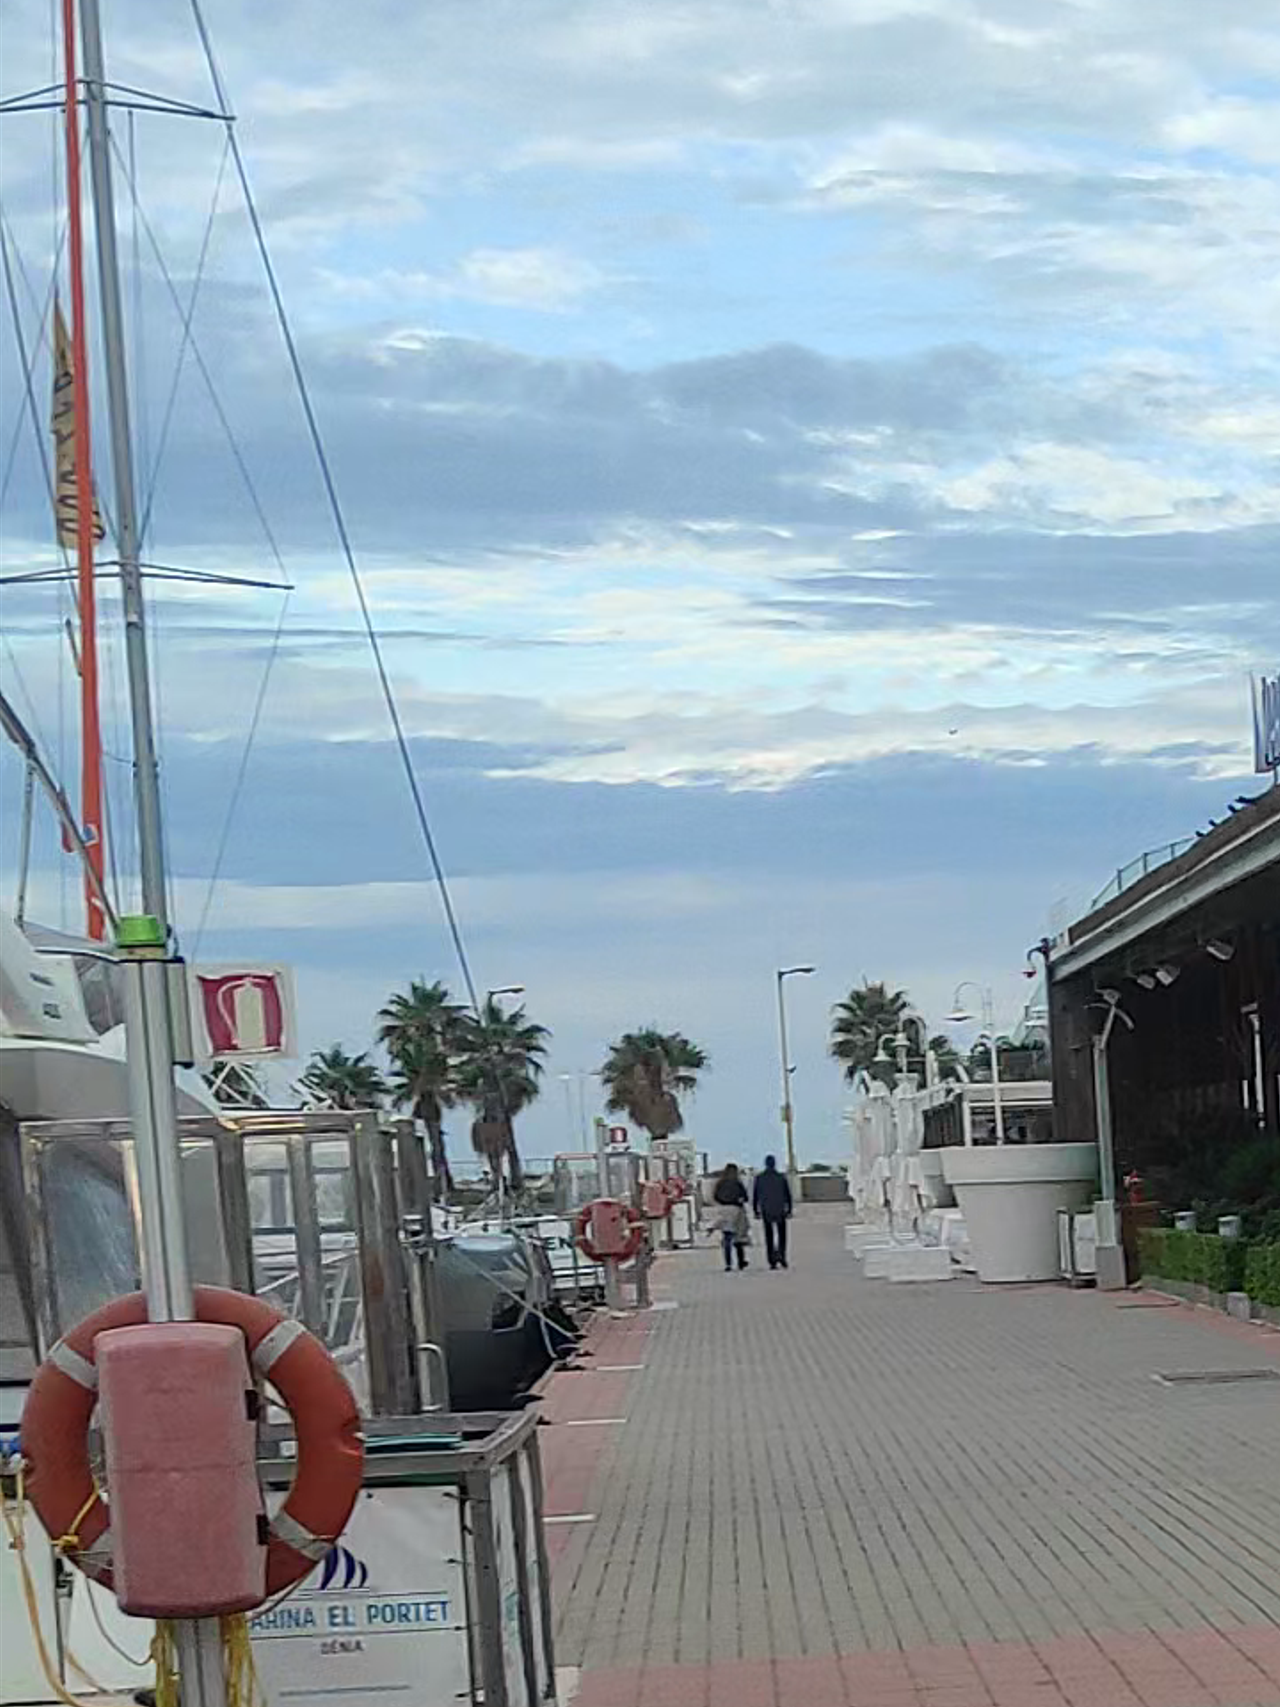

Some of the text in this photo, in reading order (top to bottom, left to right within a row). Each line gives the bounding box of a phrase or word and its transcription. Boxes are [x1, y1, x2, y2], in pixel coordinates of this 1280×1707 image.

[250, 1601, 450, 1631] ARINA EL PORTET
